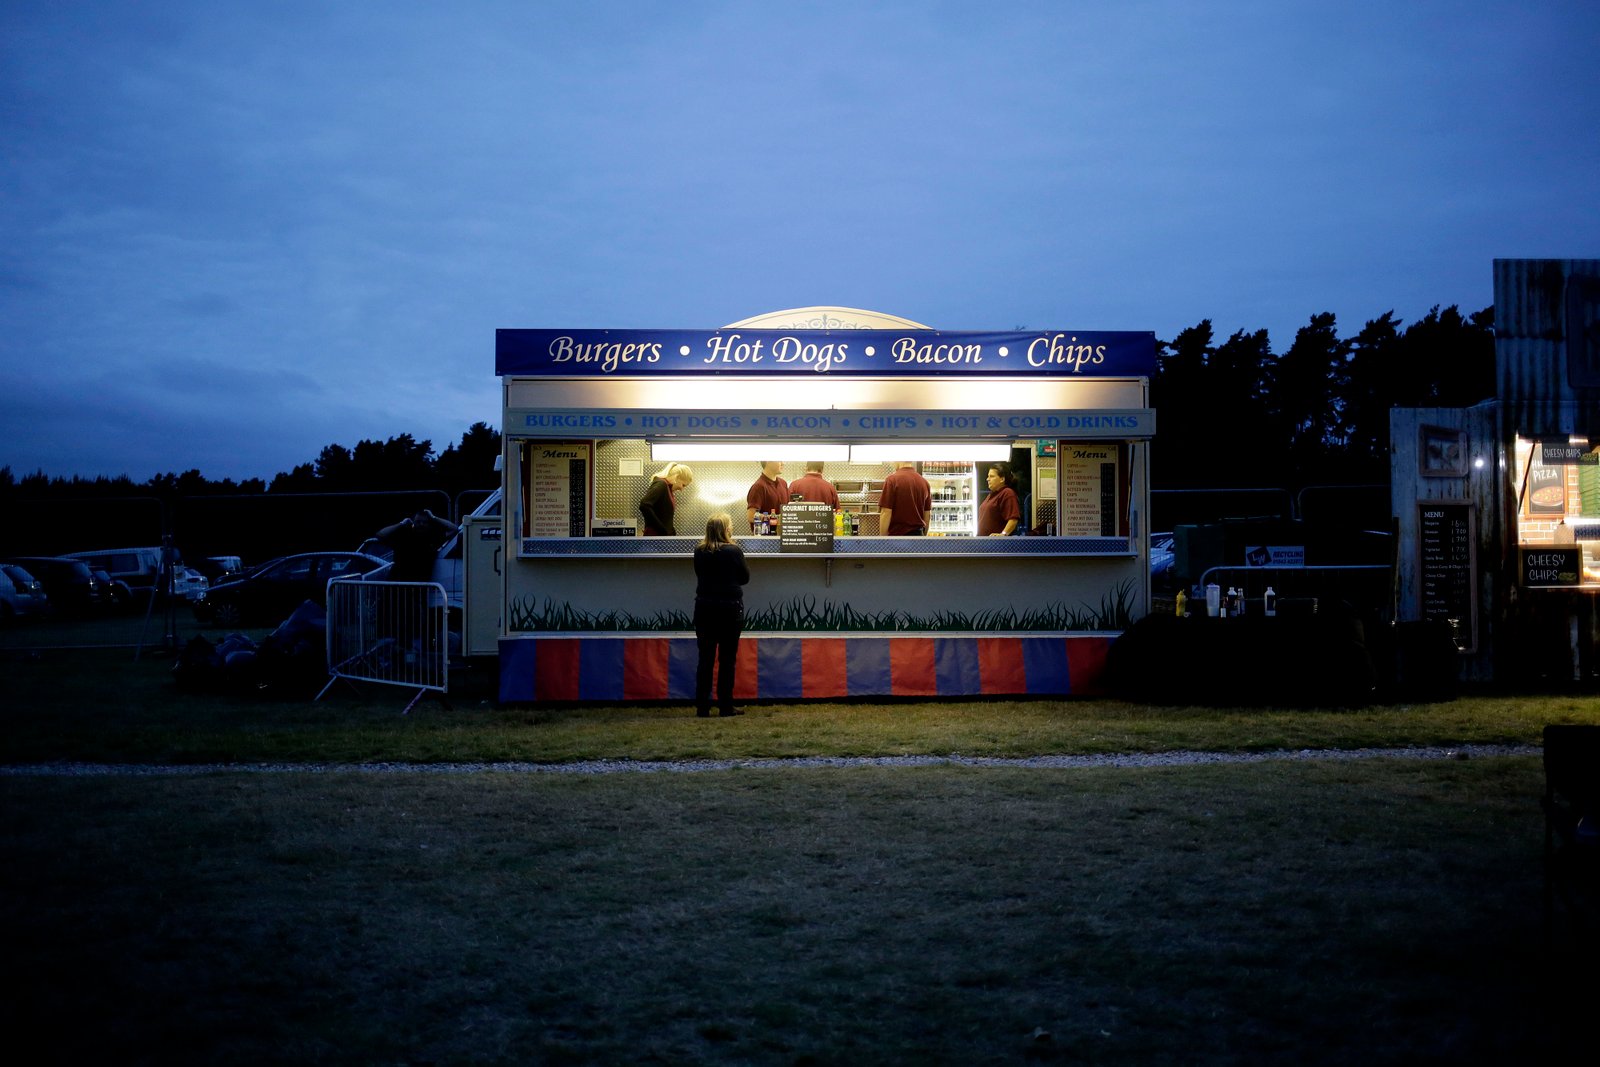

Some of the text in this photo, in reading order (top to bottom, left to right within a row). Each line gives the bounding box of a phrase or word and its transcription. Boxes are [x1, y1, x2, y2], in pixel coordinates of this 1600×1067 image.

[549, 333, 1106, 373] Burgers Hot Dogs Bacon Chips
[525, 415, 1138, 428] BURGERS HOT DOGS BACON CHIPS HOT & COLD DRINKS
[543, 450, 578, 458] Menu
[1073, 450, 1107, 459] Menu
[1544, 448, 1581, 459] CHEESY CHIPS
[1533, 469, 1558, 484] PIZZA
[1528, 554, 1565, 566] CHEESY
[1529, 569, 1558, 581] CHIPS
